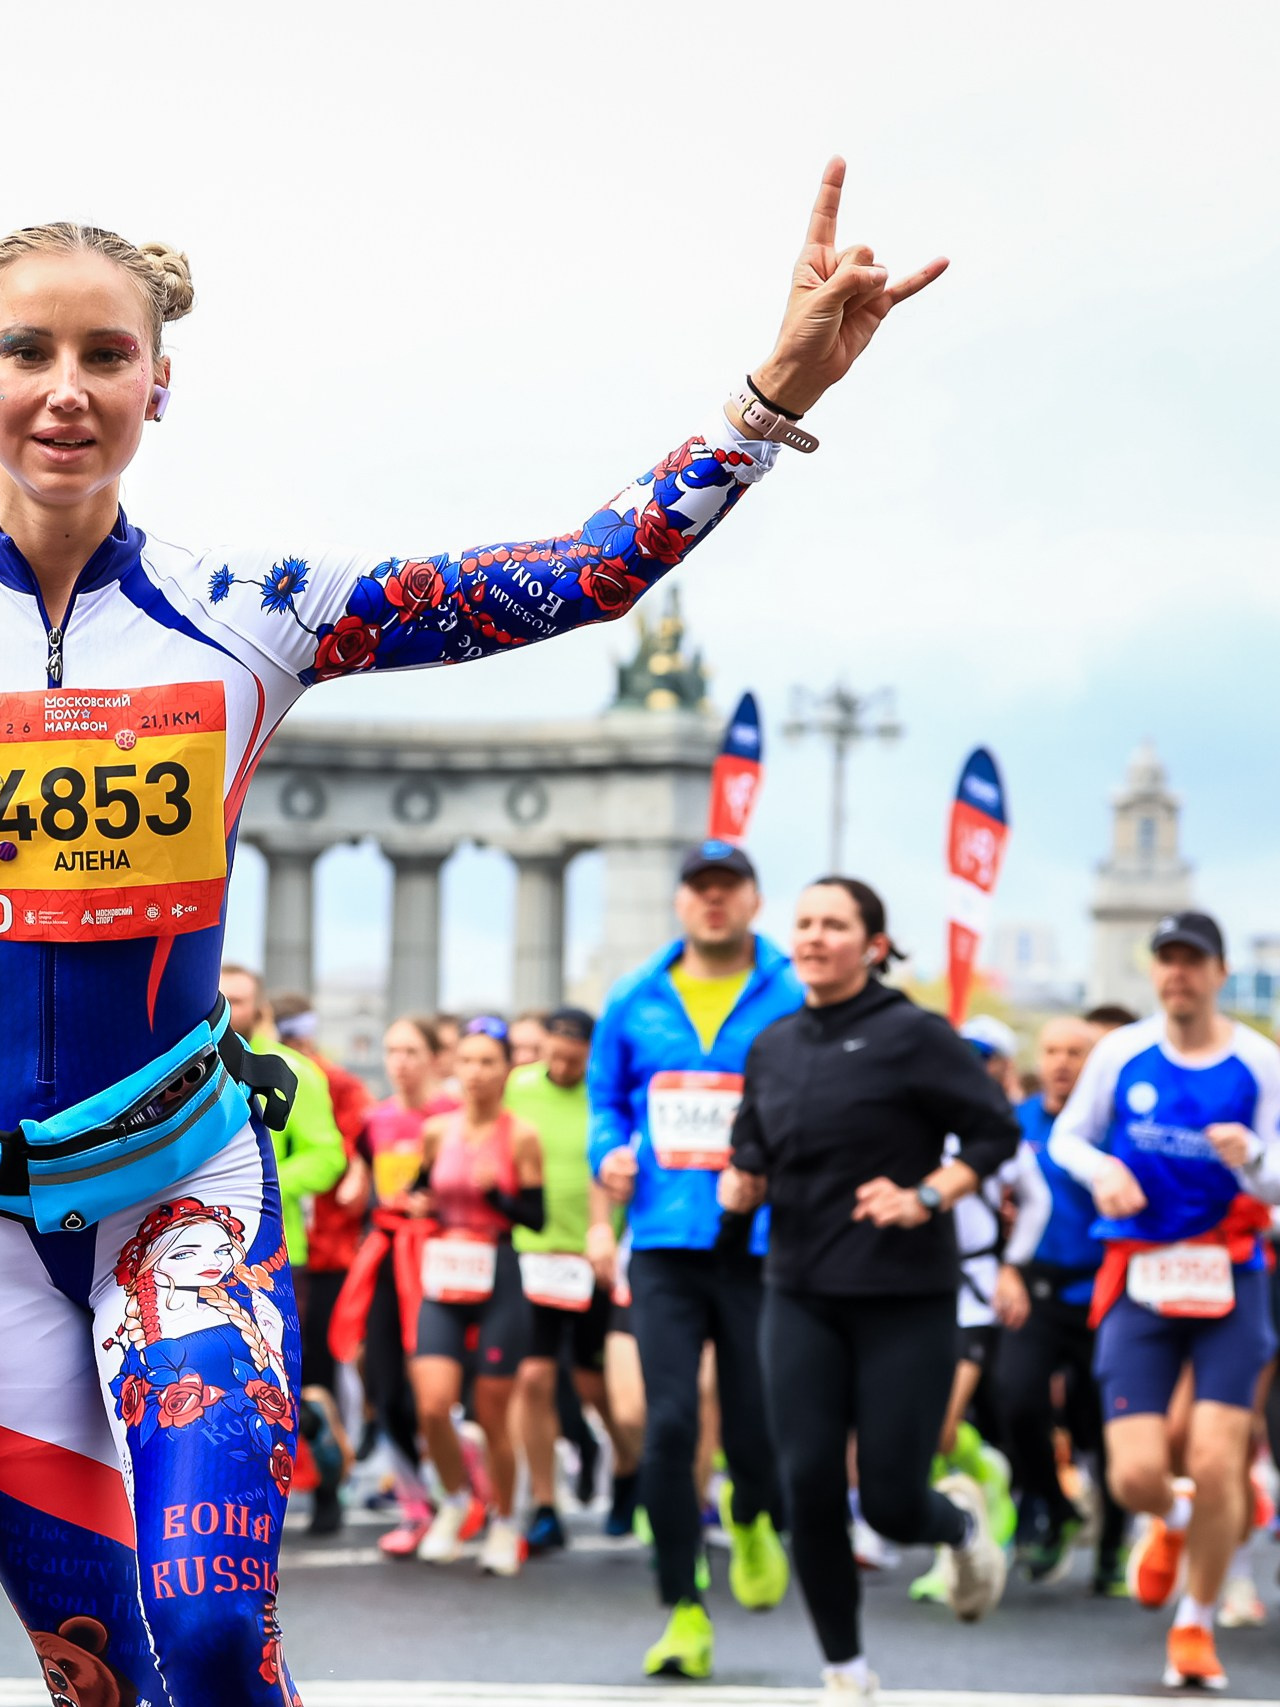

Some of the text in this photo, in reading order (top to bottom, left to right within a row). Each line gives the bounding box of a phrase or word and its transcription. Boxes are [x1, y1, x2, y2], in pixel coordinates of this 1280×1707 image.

[44, 693, 131, 708] МОСКОВСКИЙ
[44, 709, 80, 720] ПОЛУ
[44, 721, 108, 732] МАРАФОН
[140, 713, 169, 730] 21,1
[54, 849, 131, 872] АЛЕНА
[96, 906, 133, 917] МОСКОВСКИЙ
[96, 916, 114, 924] СПОРТ
[162, 1502, 271, 1544] BONA
